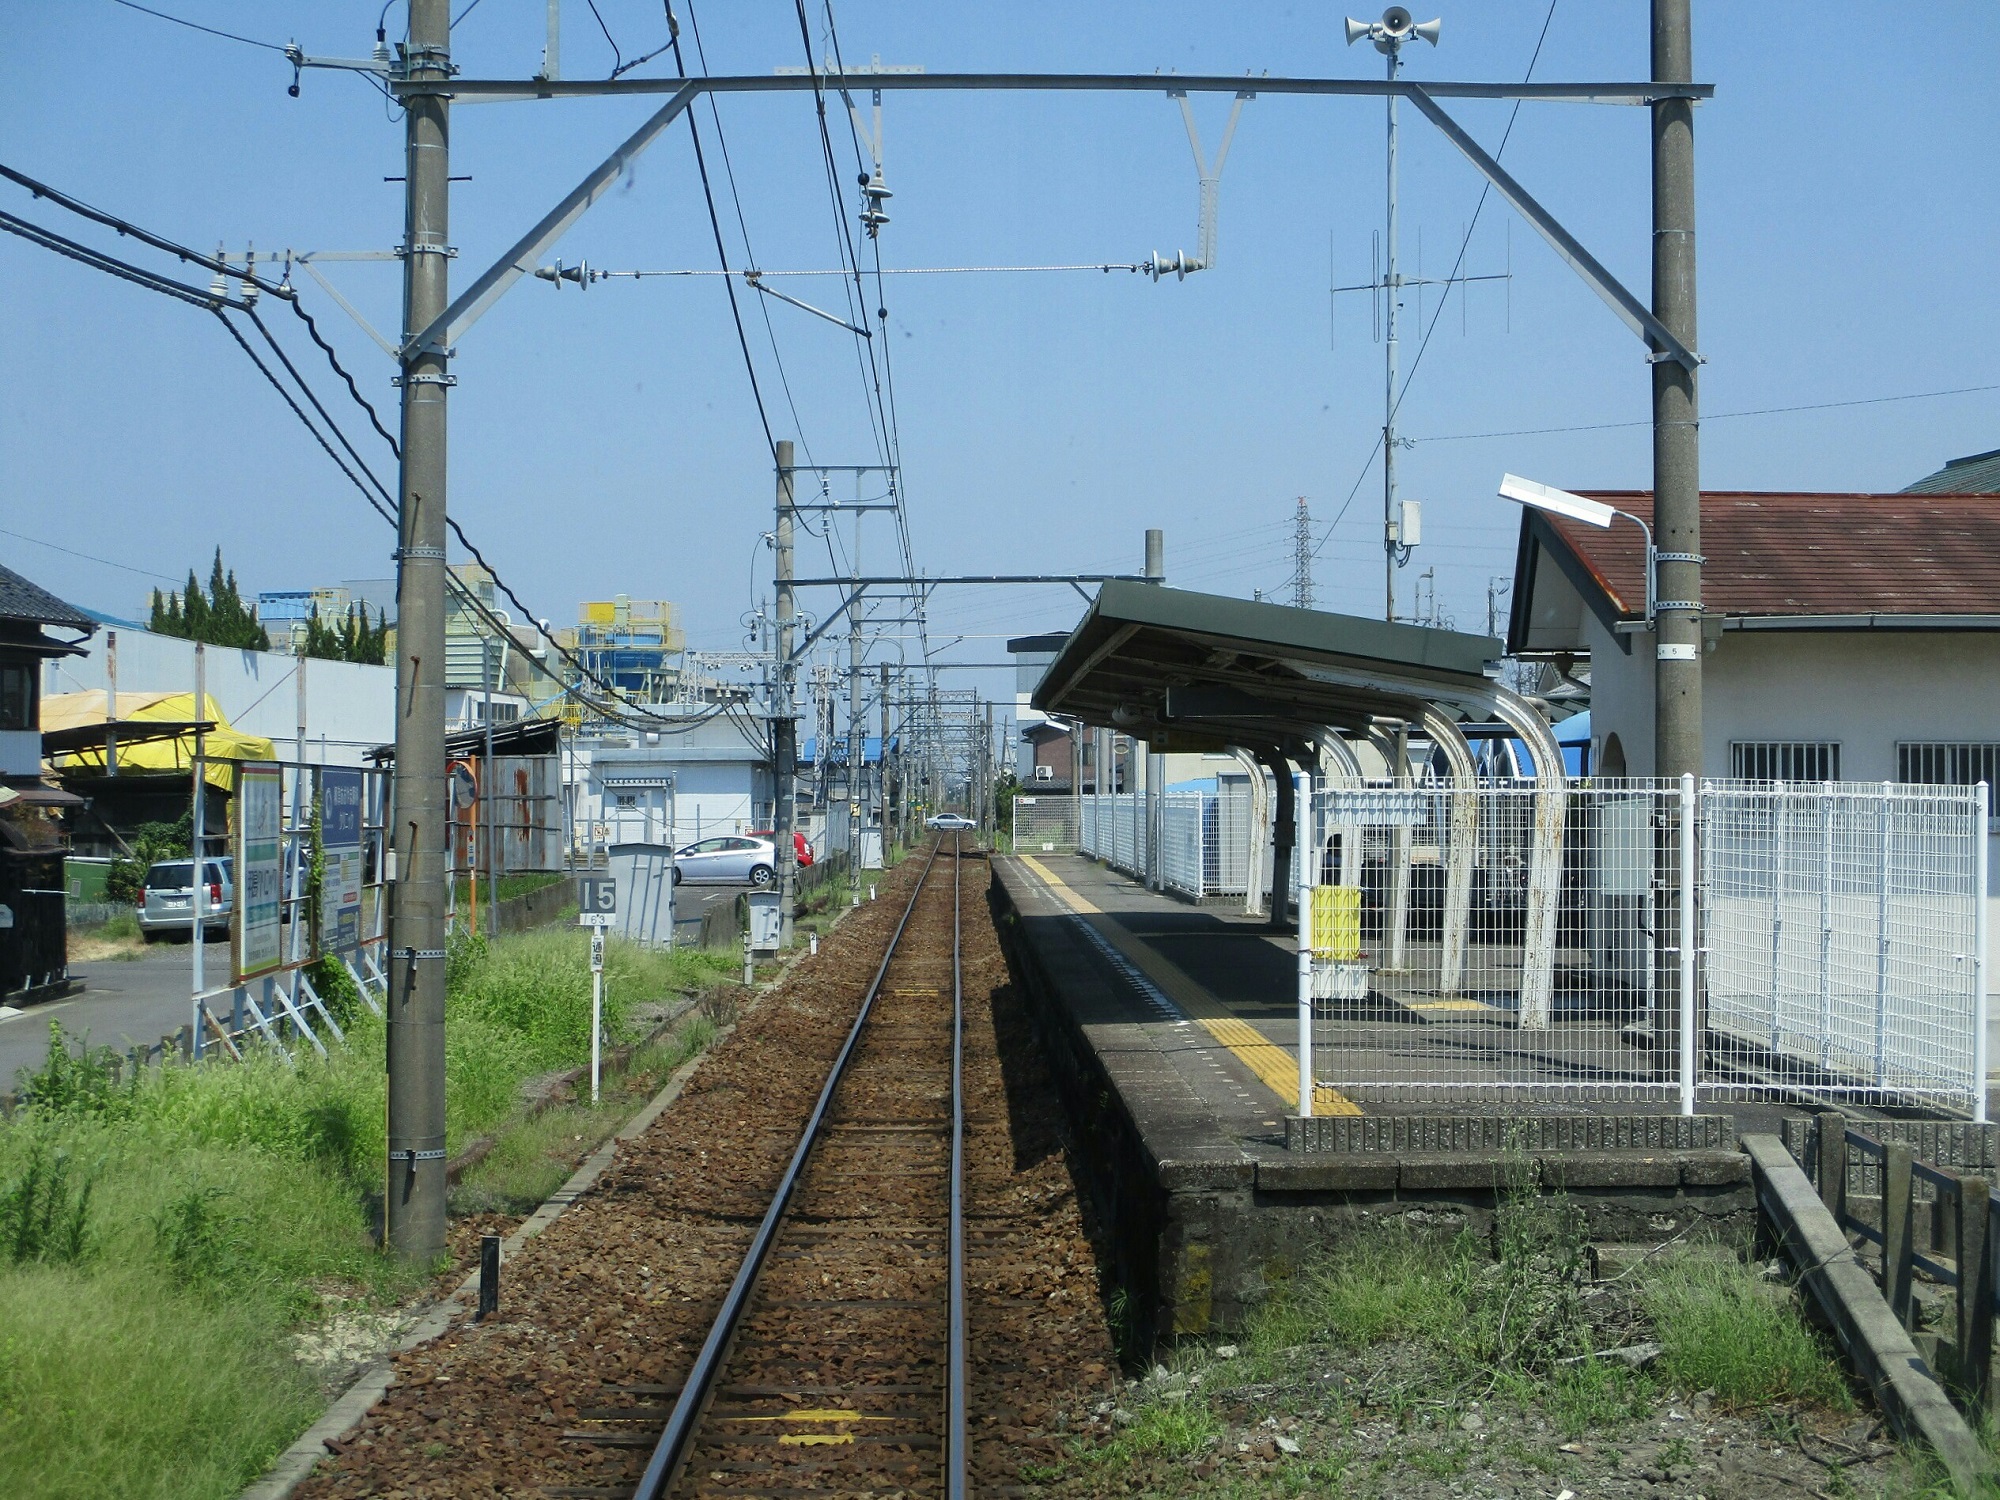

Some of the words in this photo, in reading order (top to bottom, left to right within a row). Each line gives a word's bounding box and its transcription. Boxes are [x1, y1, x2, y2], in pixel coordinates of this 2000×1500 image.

[584, 882, 615, 910] 15
[590, 915, 605, 925] 63
[811, 933, 816, 941] 2
